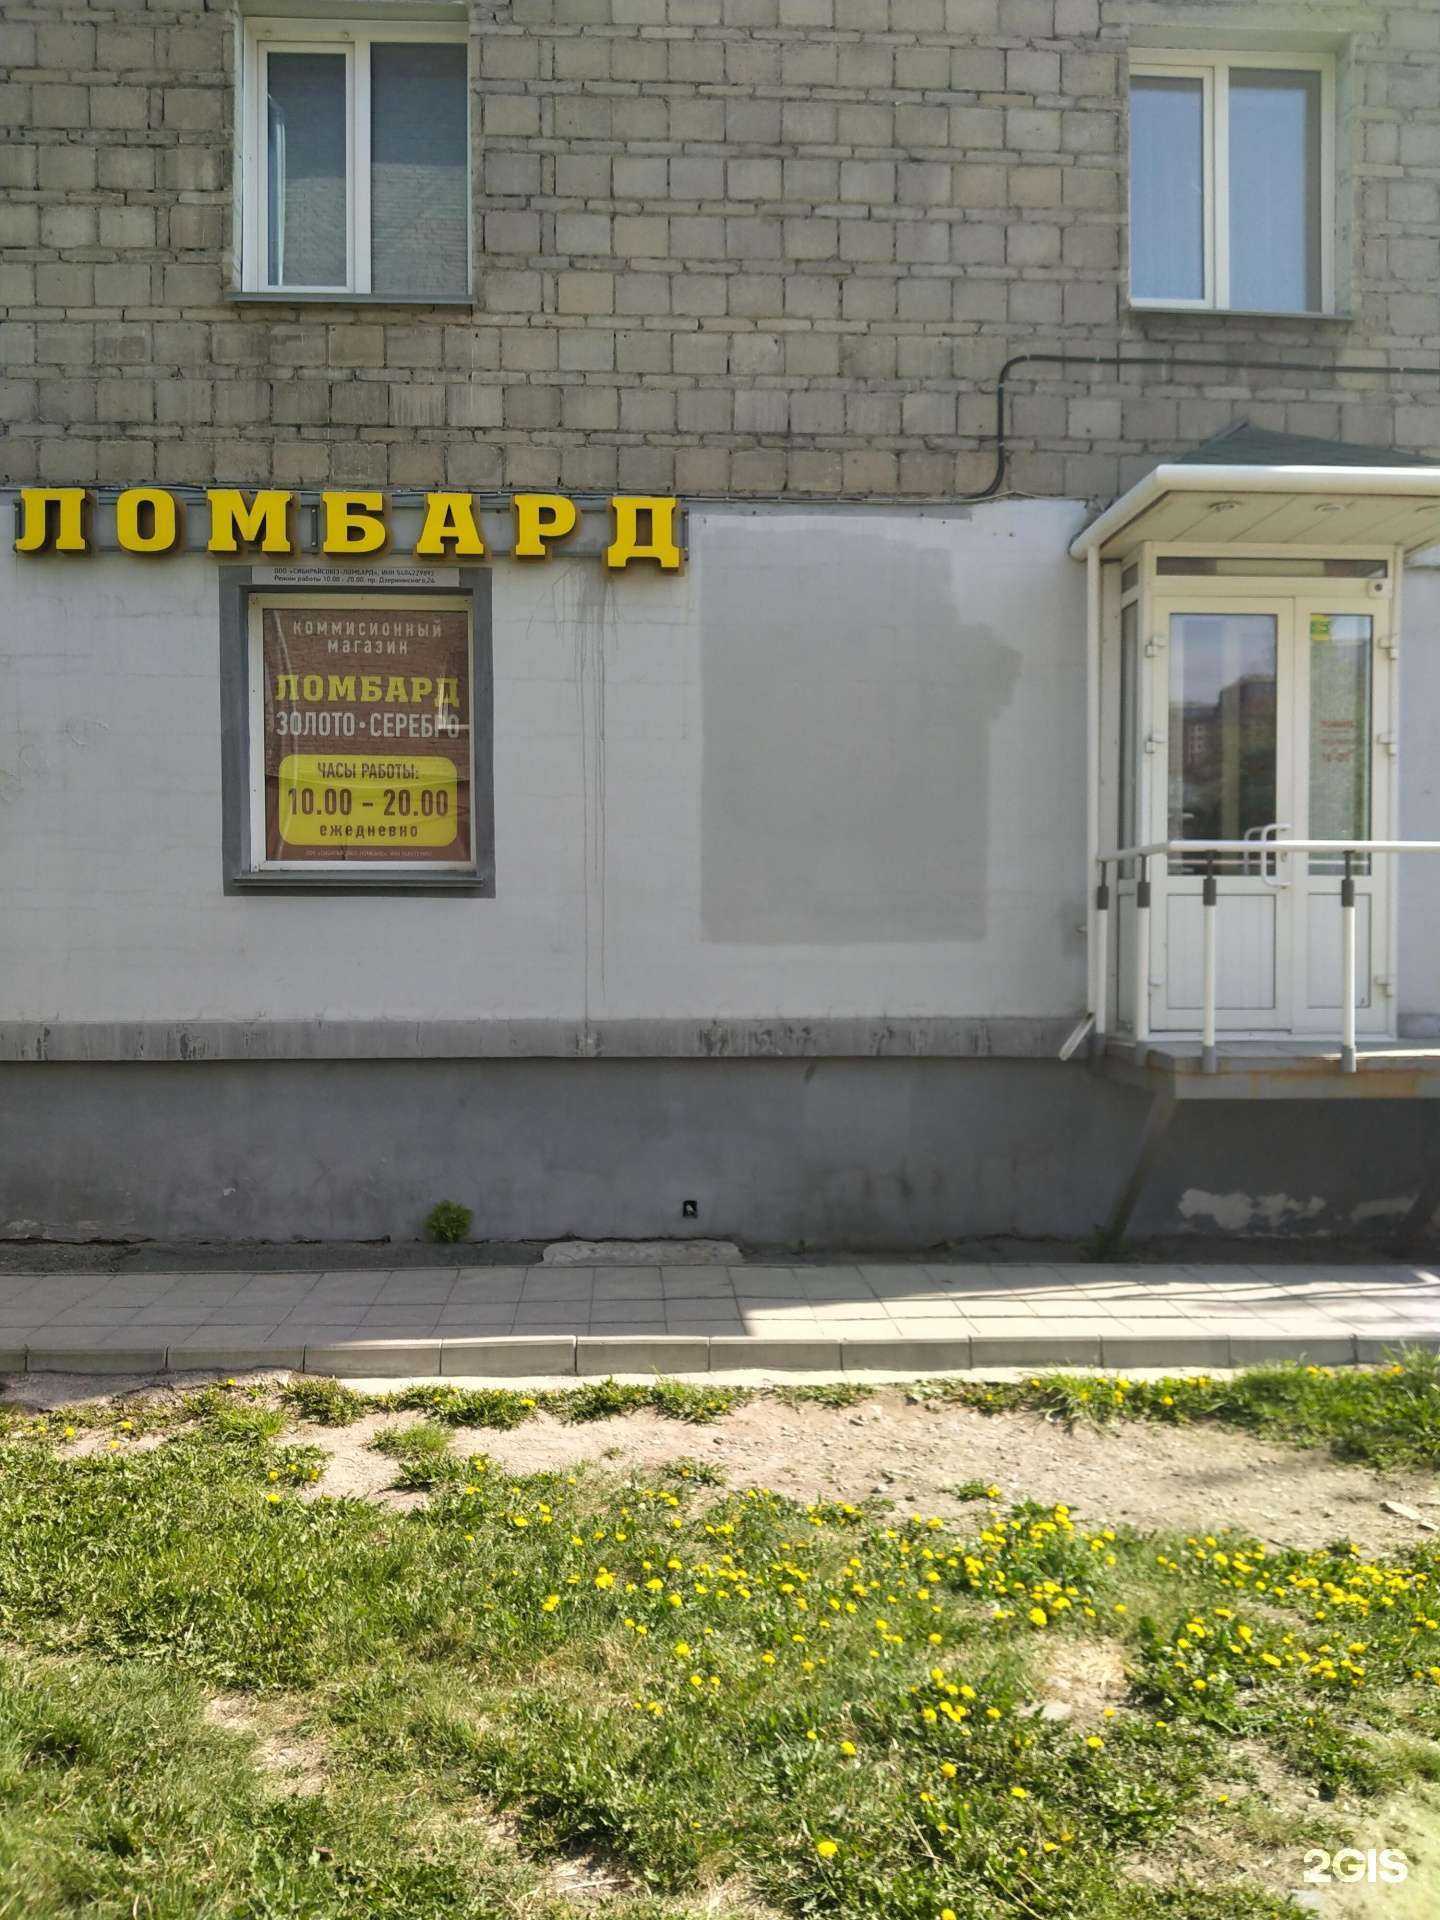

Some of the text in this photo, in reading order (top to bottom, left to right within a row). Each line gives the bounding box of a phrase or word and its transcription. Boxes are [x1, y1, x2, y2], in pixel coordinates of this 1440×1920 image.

[15, 487, 681, 569] ЛОМБАРД
[327, 639, 408, 654] магазин
[275, 674, 460, 708] ЛОМБАРД
[276, 711, 355, 737] ЗОЛОТО
[317, 762, 420, 780] ЧАСЫ РАБОТЫ:
[288, 788, 352, 816] 10.00
[383, 788, 449, 817] 20.00
[319, 824, 418, 839] ежедневно
